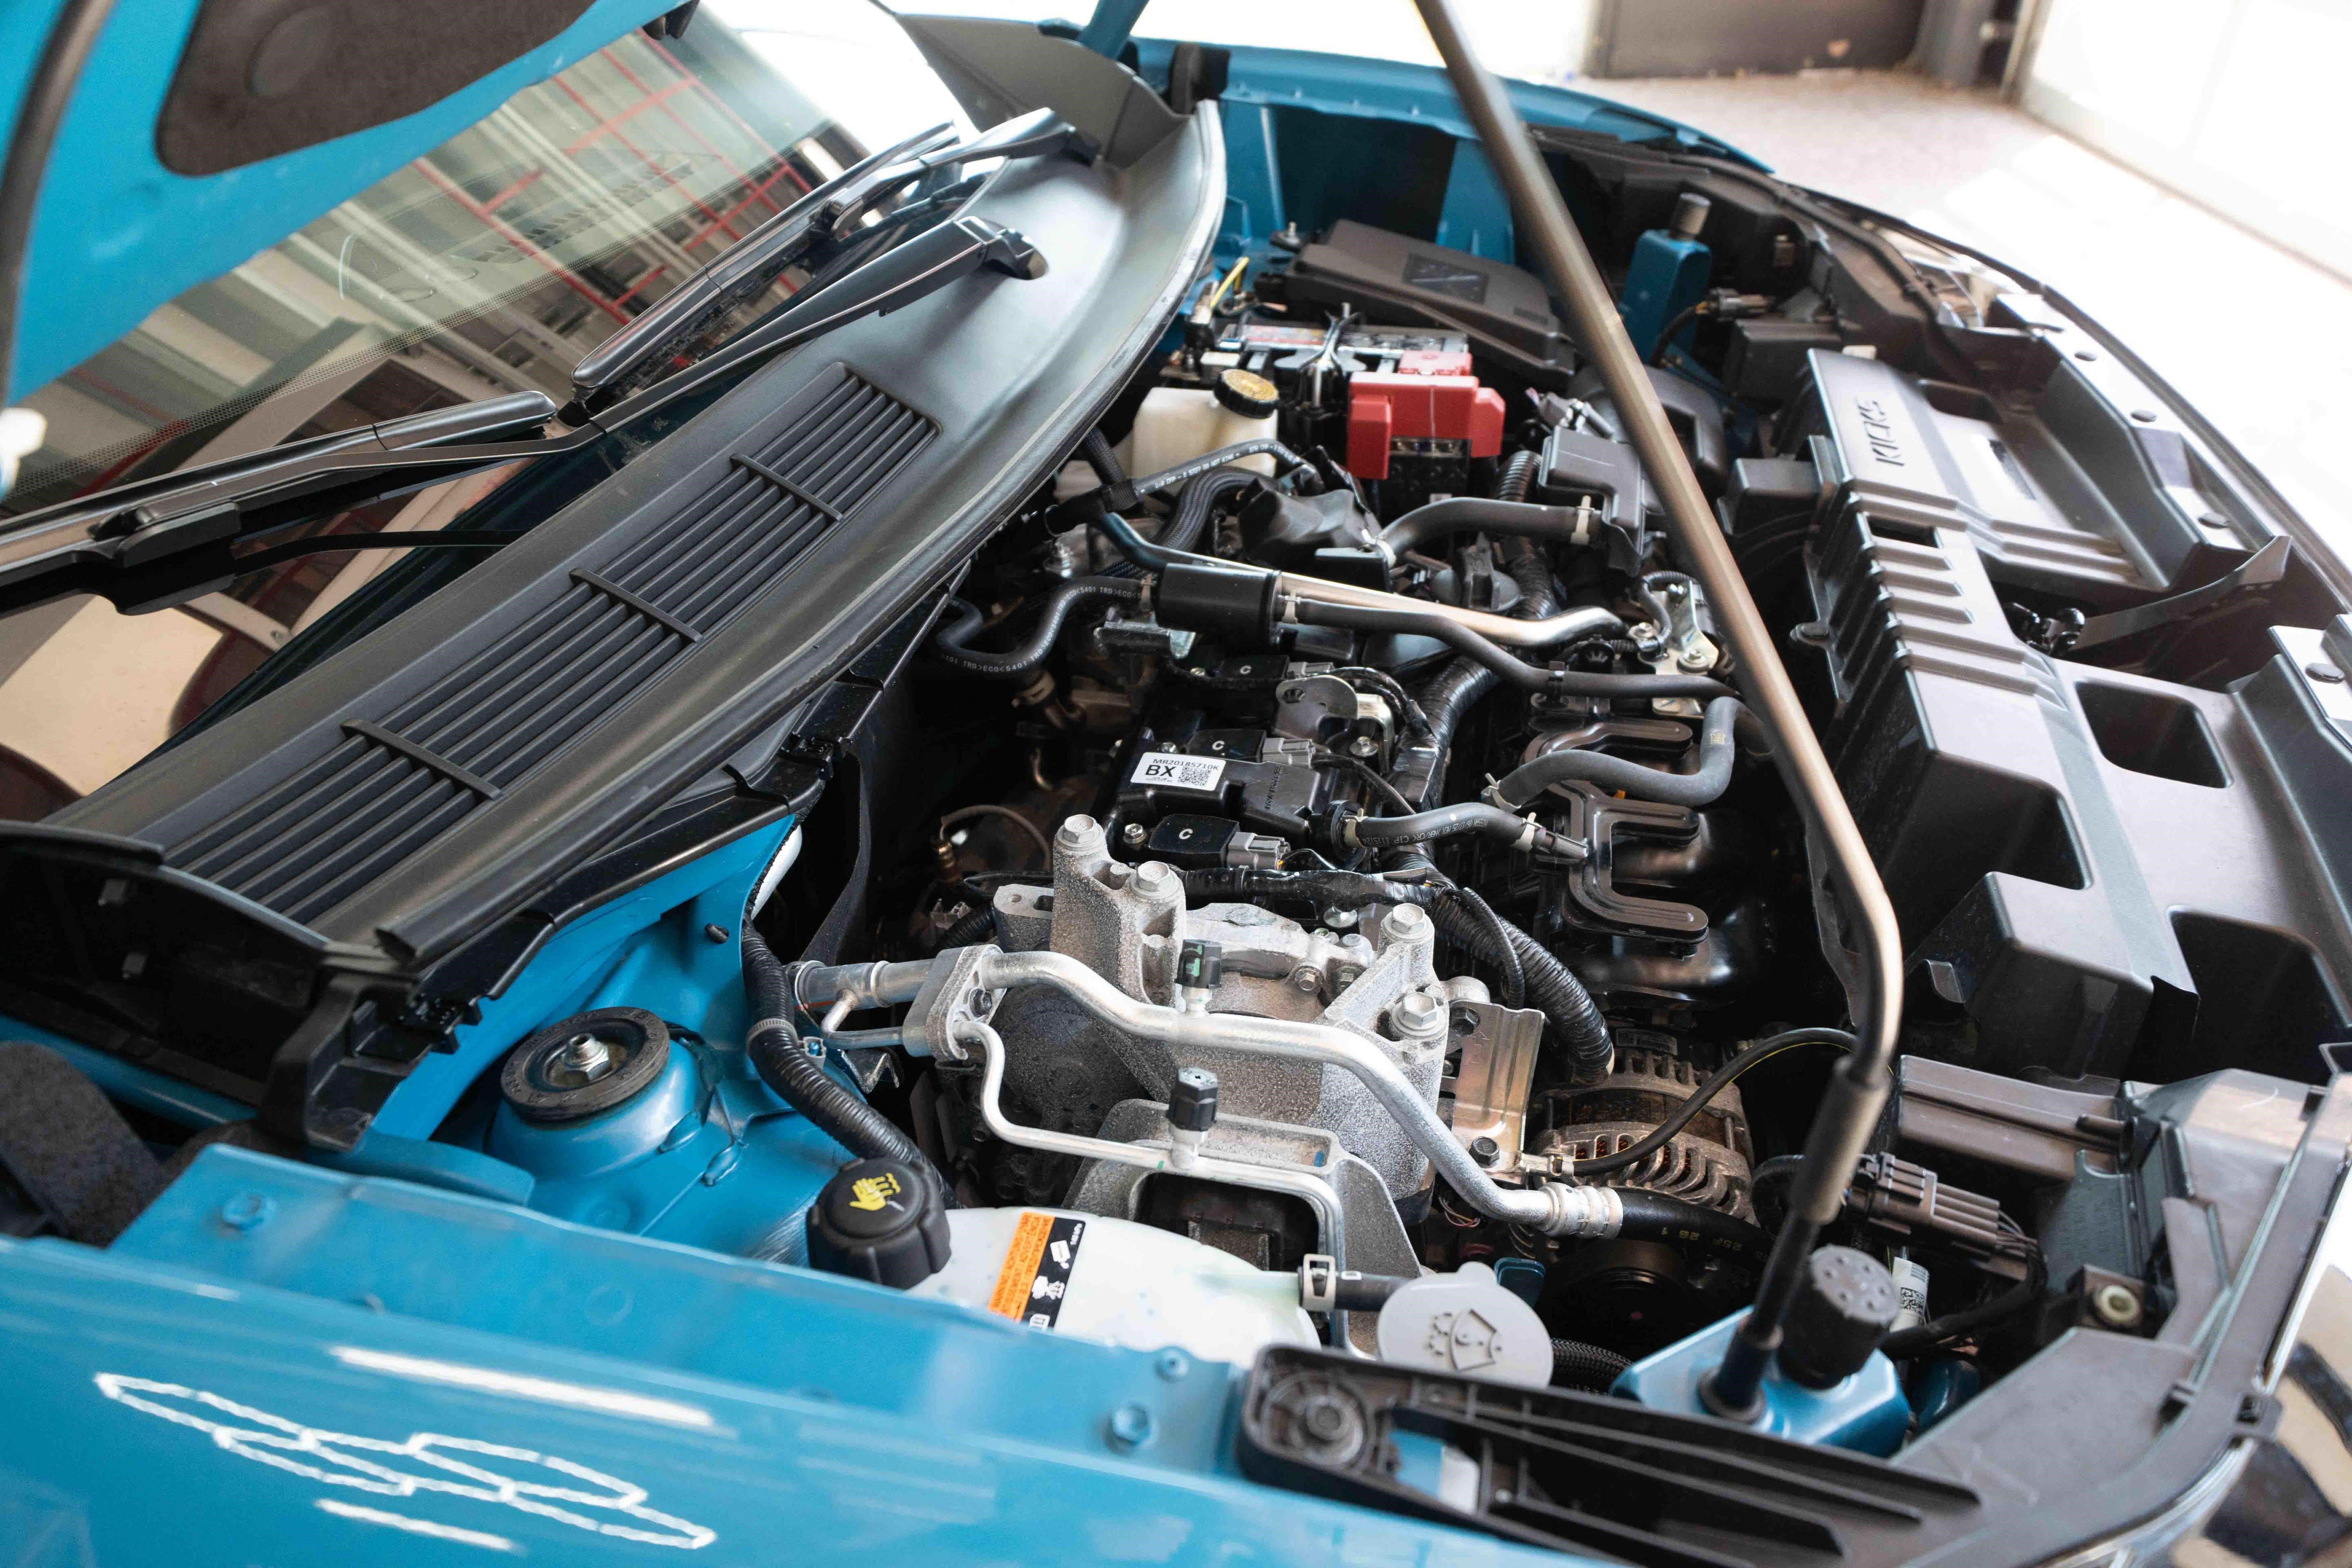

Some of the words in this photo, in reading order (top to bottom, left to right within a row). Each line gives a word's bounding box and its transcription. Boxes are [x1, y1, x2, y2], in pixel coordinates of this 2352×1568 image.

[1855, 398, 1905, 467] KICKS
[1239, 664, 1252, 675] C
[1212, 740, 1225, 751] C
[1145, 764, 1176, 777] BX
[1153, 758, 1220, 771] MR20185710K
[1178, 828, 1193, 840] C
